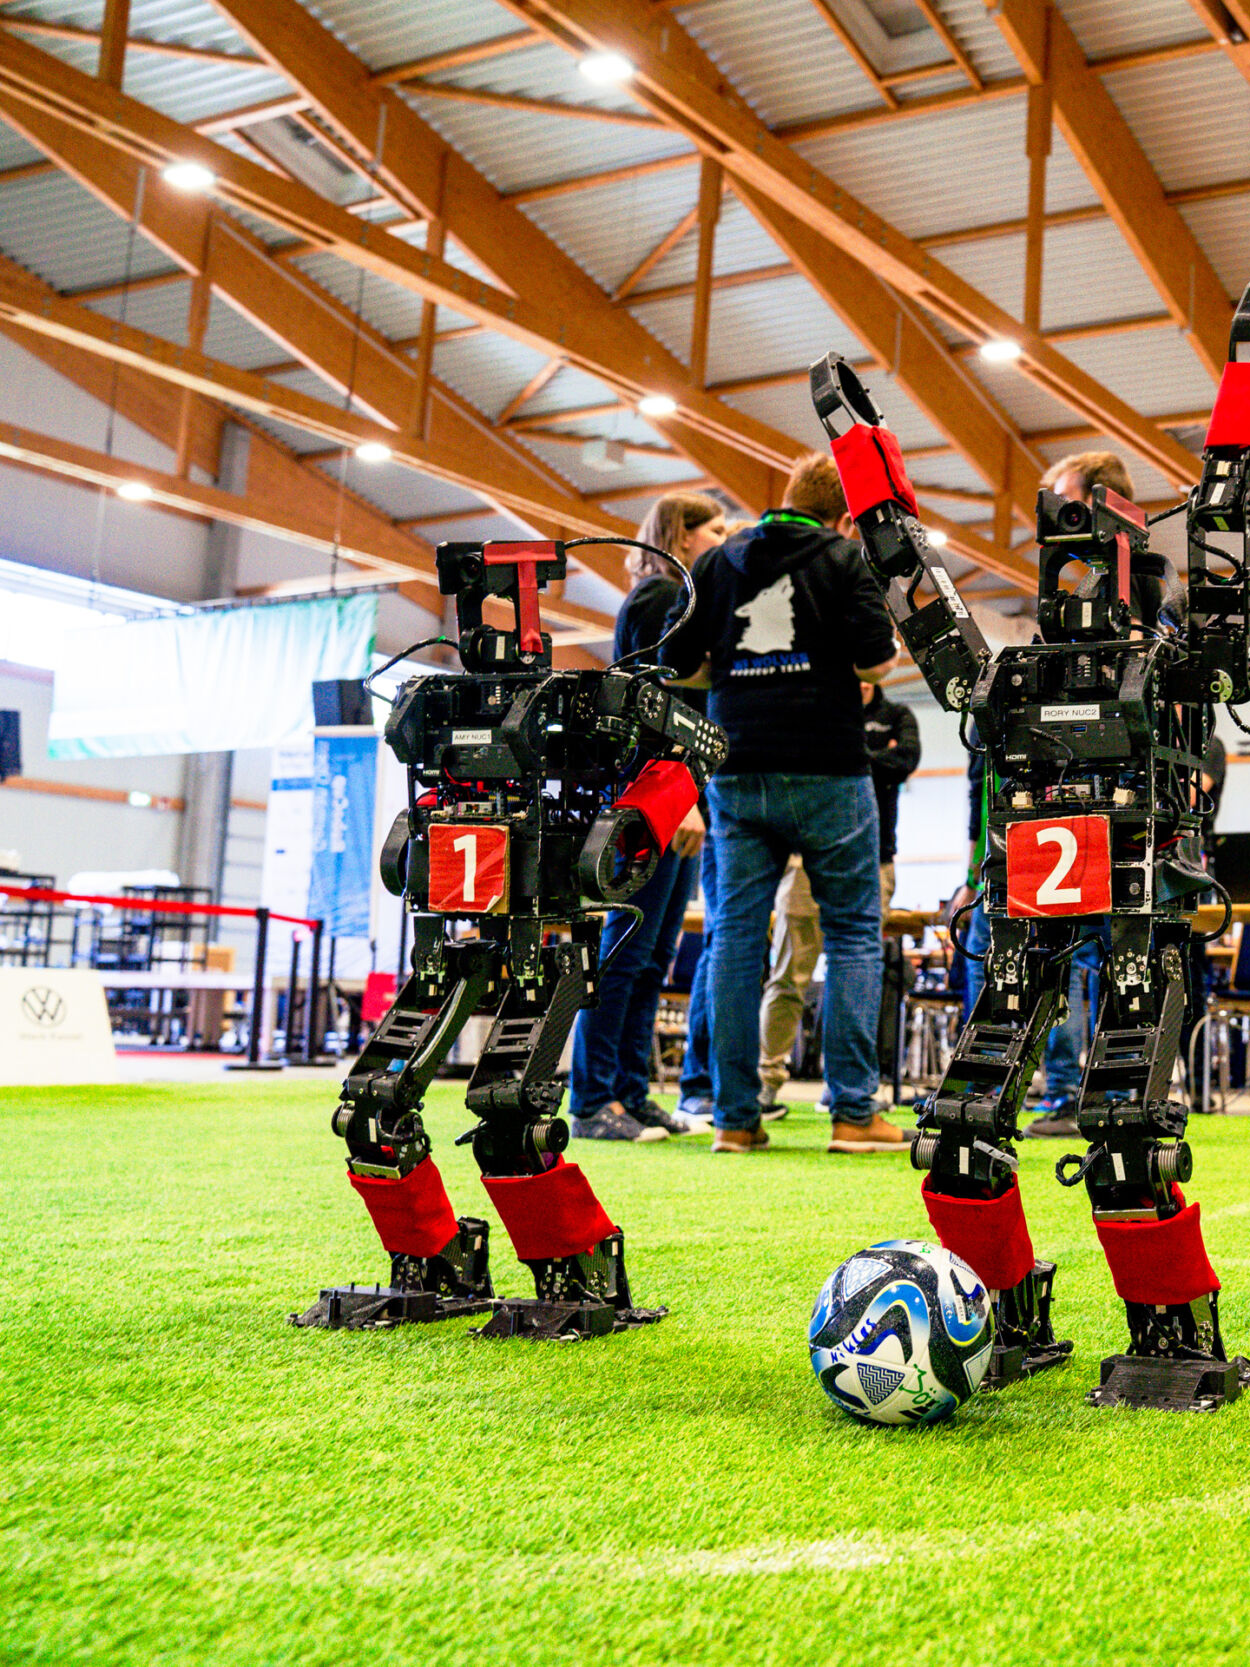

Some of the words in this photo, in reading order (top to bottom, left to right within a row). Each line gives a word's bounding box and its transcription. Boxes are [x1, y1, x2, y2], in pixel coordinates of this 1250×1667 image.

[1044, 710, 1070, 718] RORY
[1072, 708, 1097, 717] NUC2
[455, 733, 470, 741] AMY
[471, 732, 491, 740] NUC1
[453, 834, 477, 902] 1
[1036, 826, 1082, 906] 2
